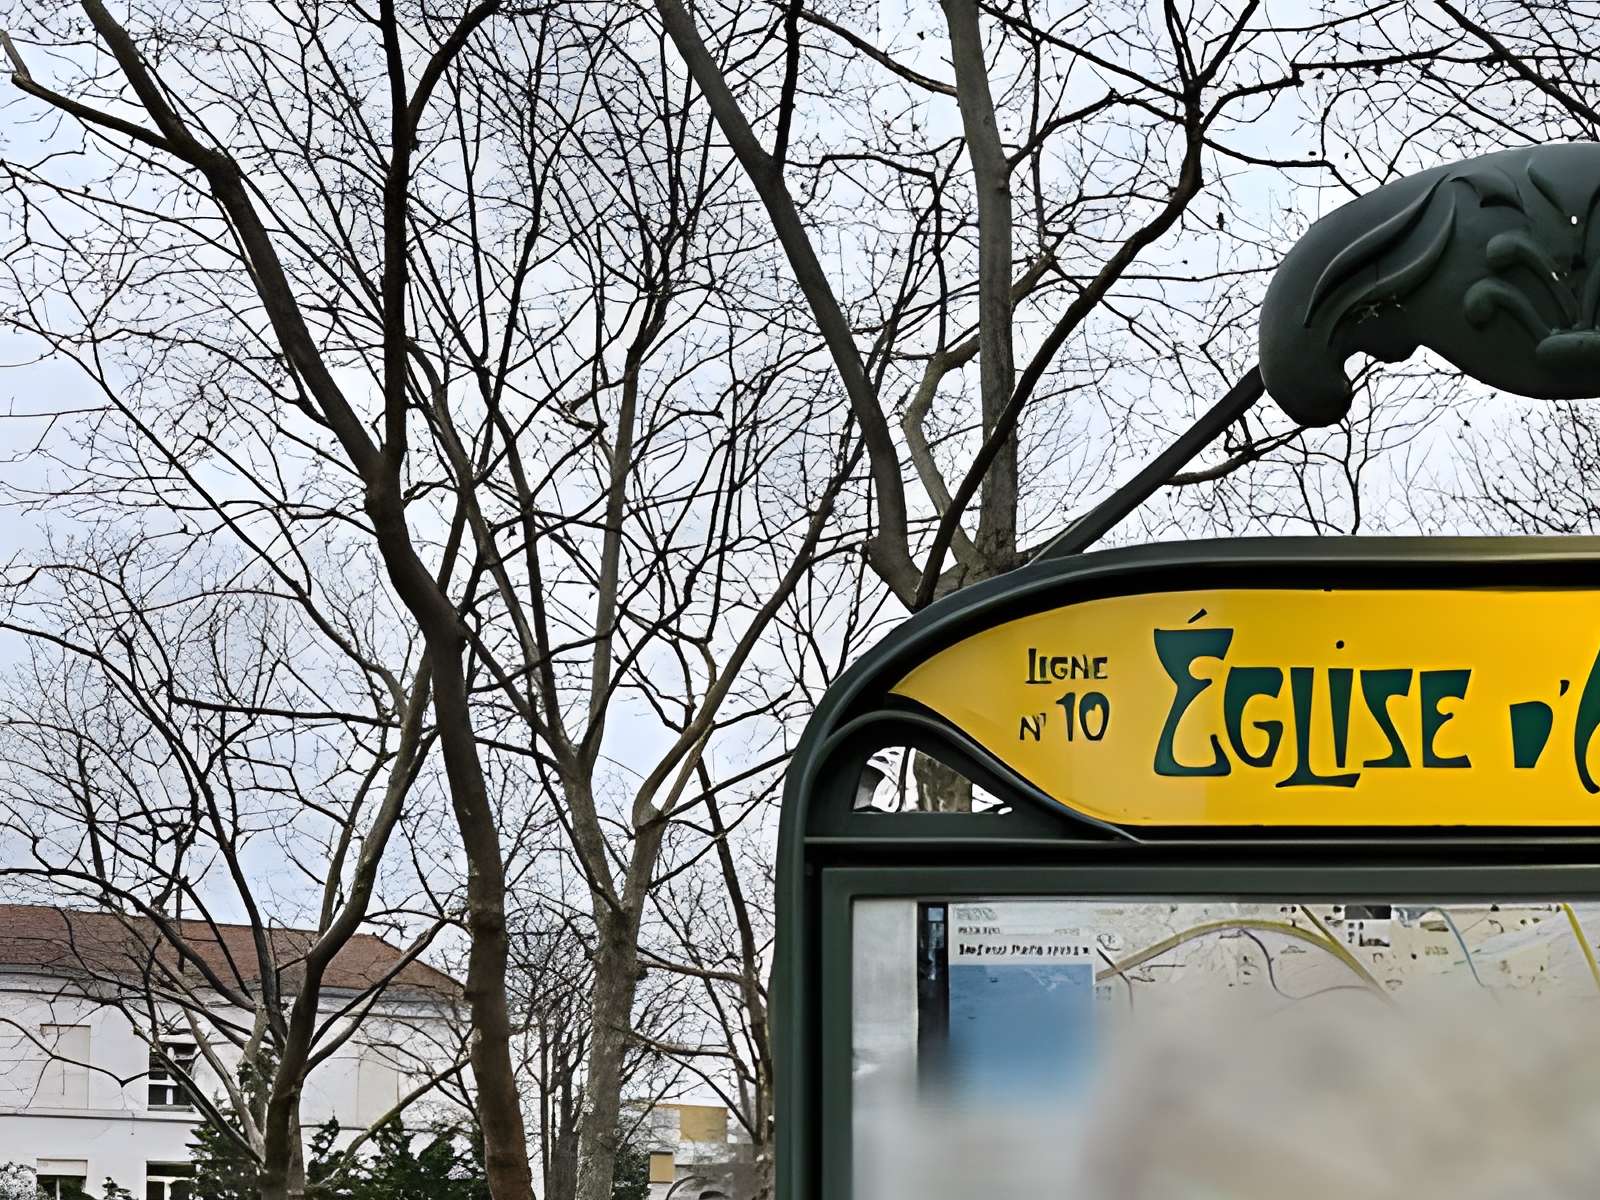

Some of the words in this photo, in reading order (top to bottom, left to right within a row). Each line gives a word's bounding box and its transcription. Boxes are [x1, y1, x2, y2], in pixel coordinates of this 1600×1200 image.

[1024, 647, 1109, 685] LIGNE
[1055, 691, 1110, 742] 10
[1153, 608, 1472, 789] ÉGLISE
